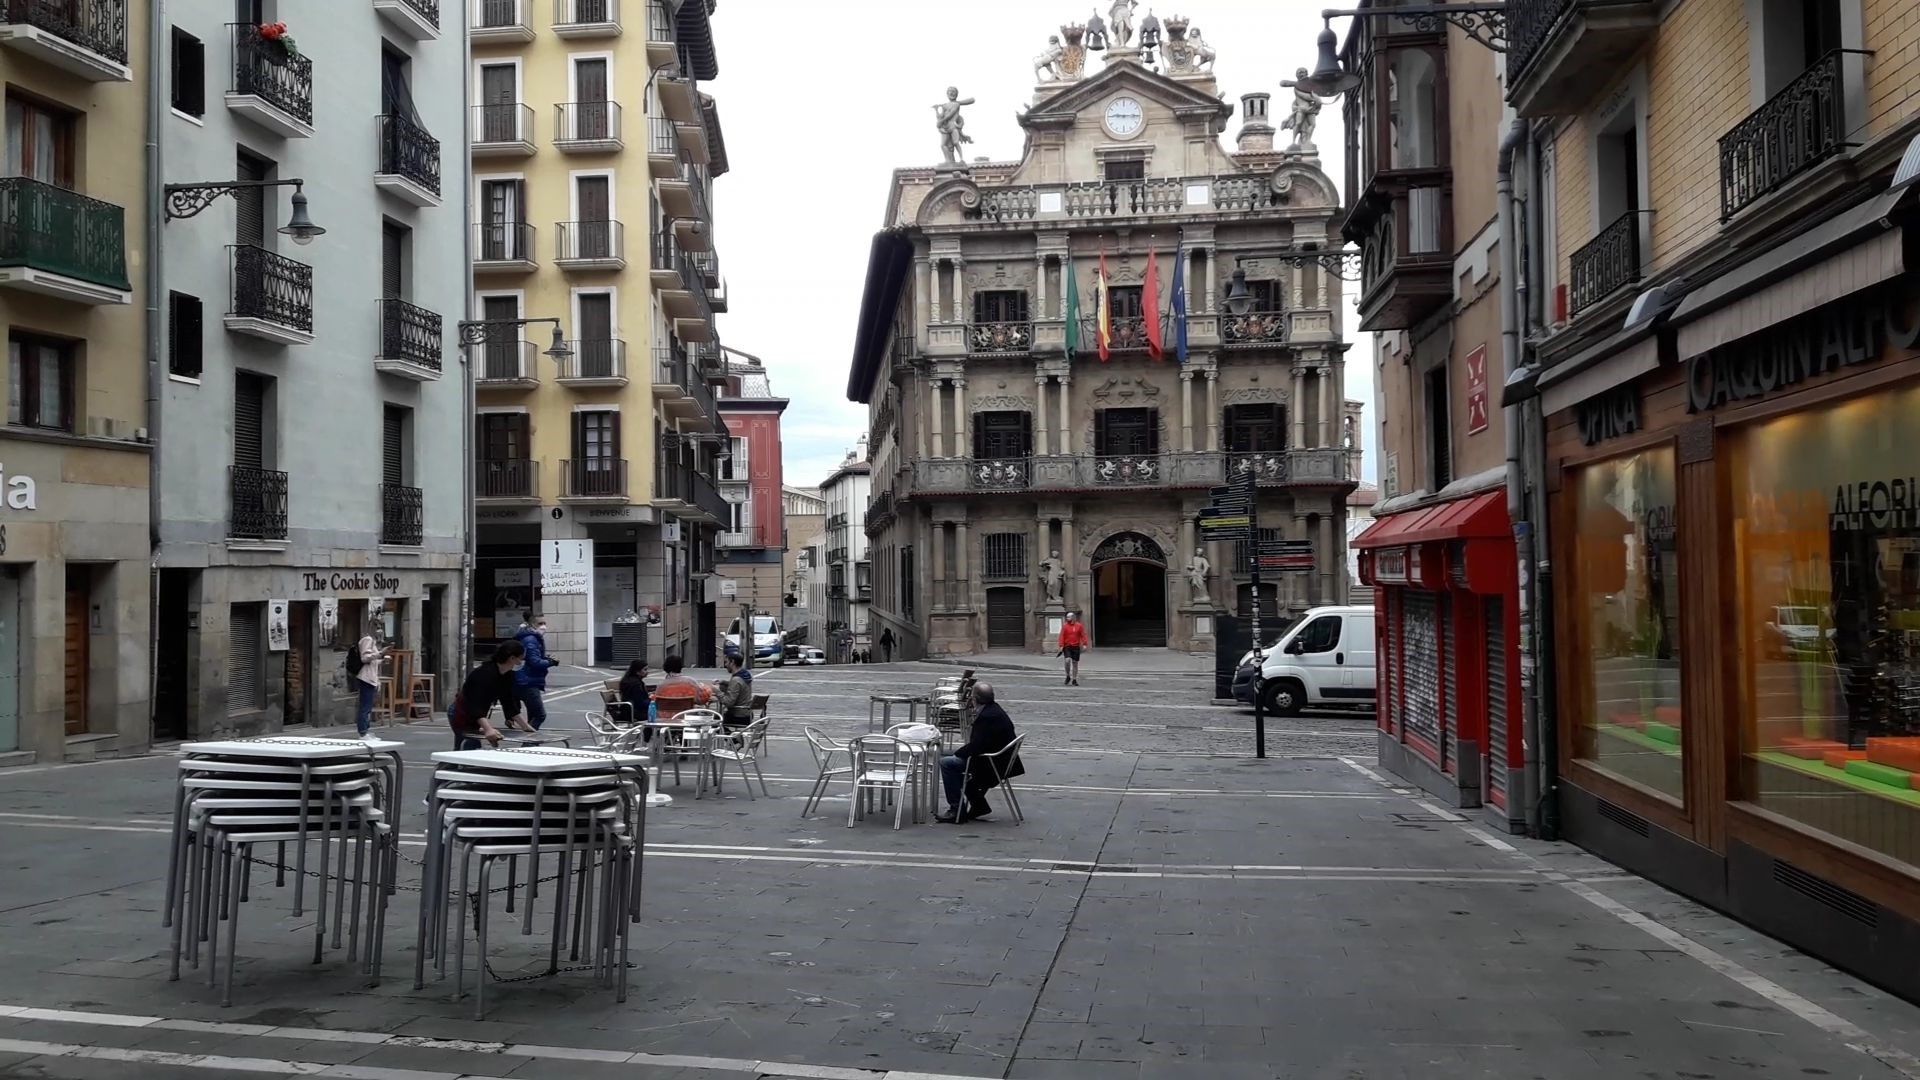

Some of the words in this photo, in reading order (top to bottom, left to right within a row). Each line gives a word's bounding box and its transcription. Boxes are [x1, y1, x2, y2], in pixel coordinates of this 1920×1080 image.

[303, 572, 327, 591] The
[330, 572, 370, 591] Cookie
[373, 572, 400, 594] Shop
